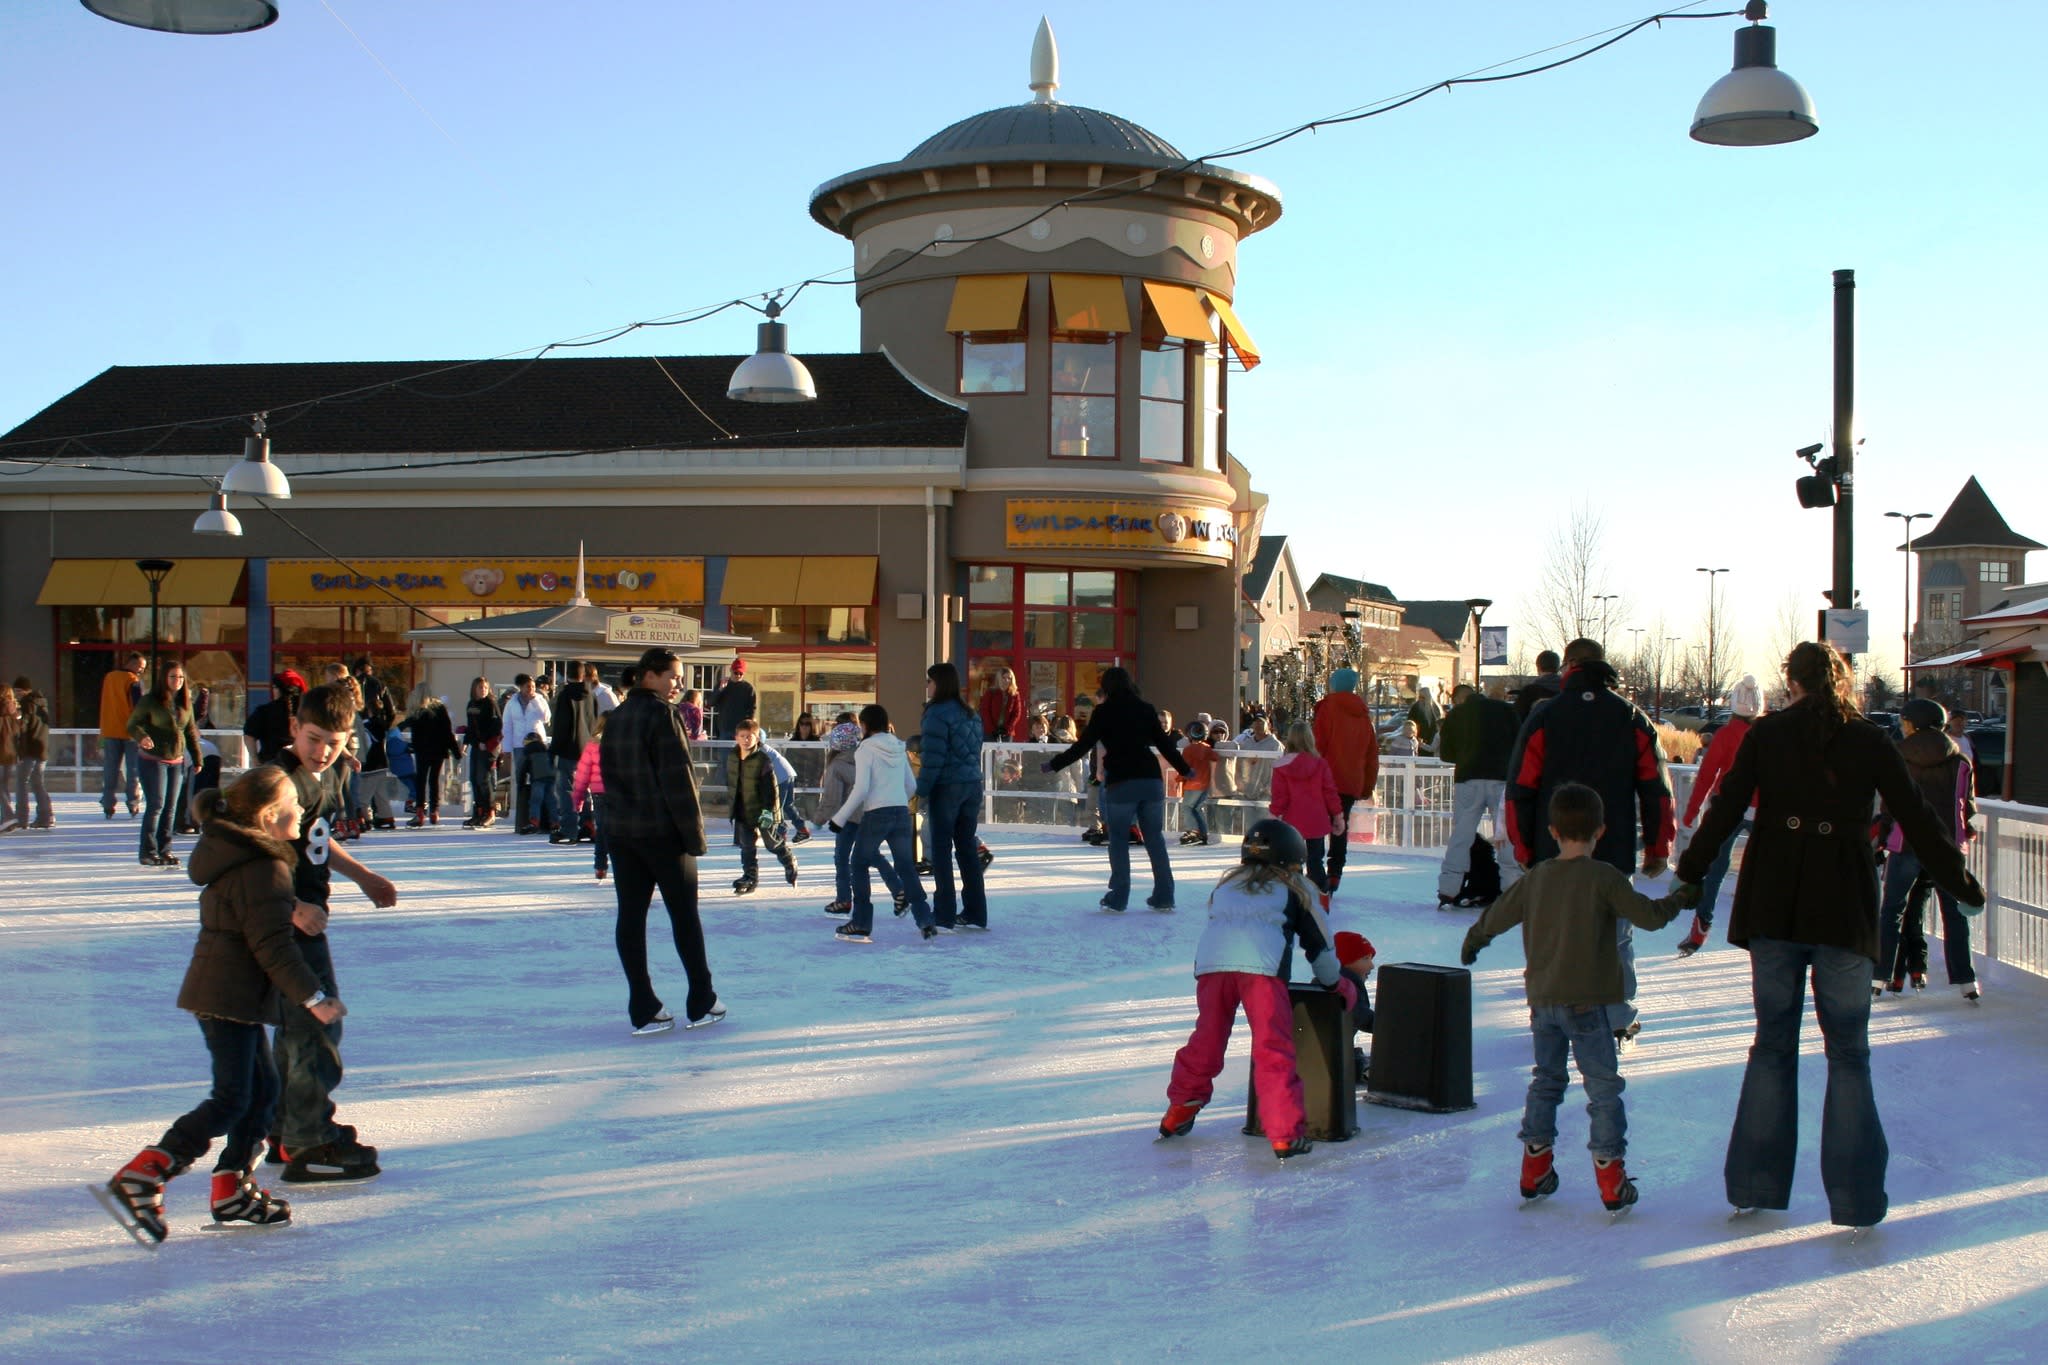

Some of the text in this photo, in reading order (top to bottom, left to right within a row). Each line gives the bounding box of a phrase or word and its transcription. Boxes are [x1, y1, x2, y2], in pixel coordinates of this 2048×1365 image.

[614, 629, 694, 642] SKATE RENTALS
[306, 816, 330, 865] 8
